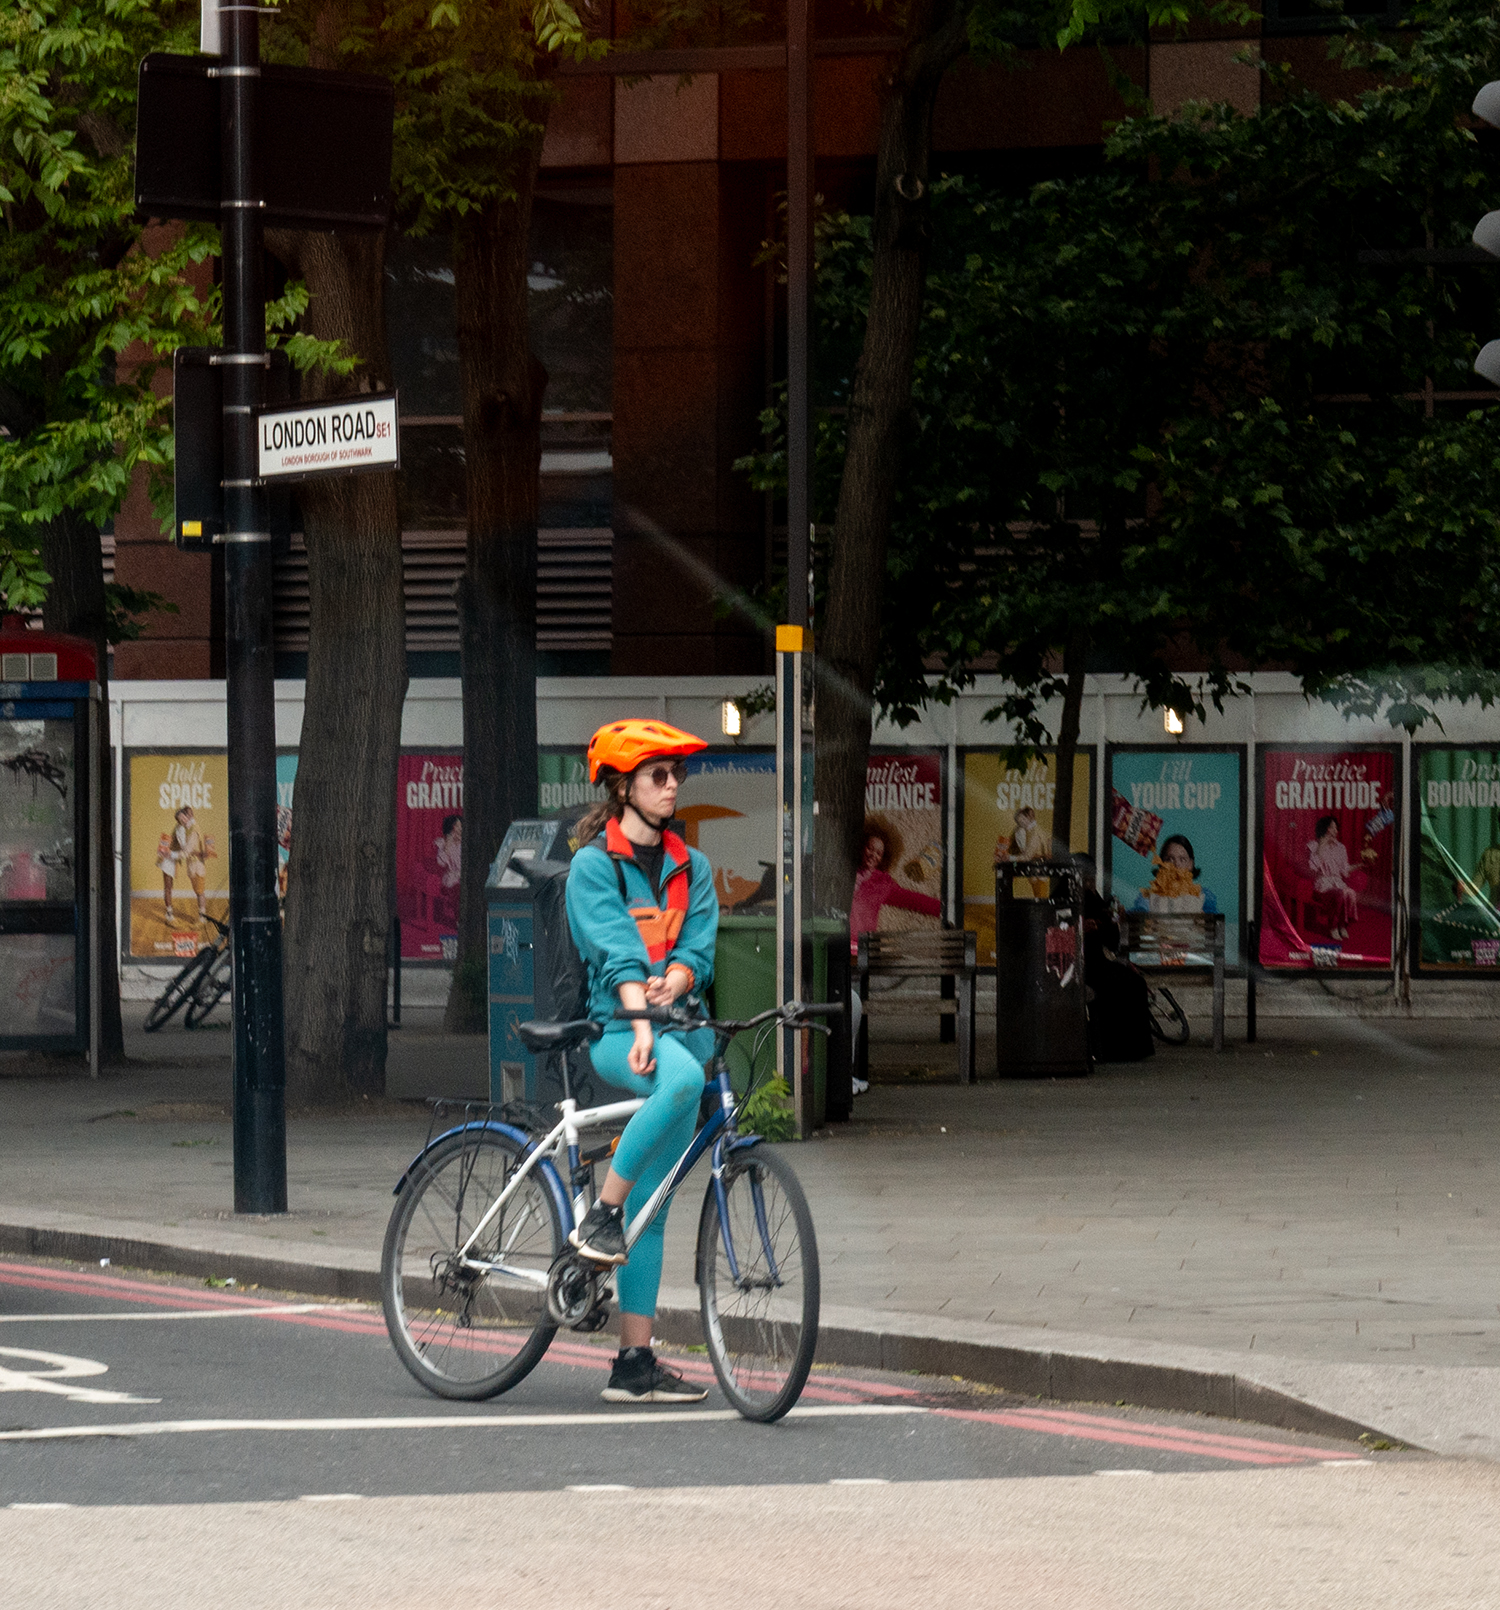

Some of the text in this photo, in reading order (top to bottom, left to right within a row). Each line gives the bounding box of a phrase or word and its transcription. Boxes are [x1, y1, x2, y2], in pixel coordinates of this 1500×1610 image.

[264, 410, 391, 452] LONDON ROAD SE1
[281, 446, 373, 467] LONDON BOROUGH OF SOUTHWARK
[1292, 759, 1367, 782] Practice
[159, 782, 213, 810] SPACE
[997, 782, 1056, 810] SPACE
[1130, 781, 1221, 810] YOUR CUP
[1275, 780, 1381, 810] GRATITUDE
